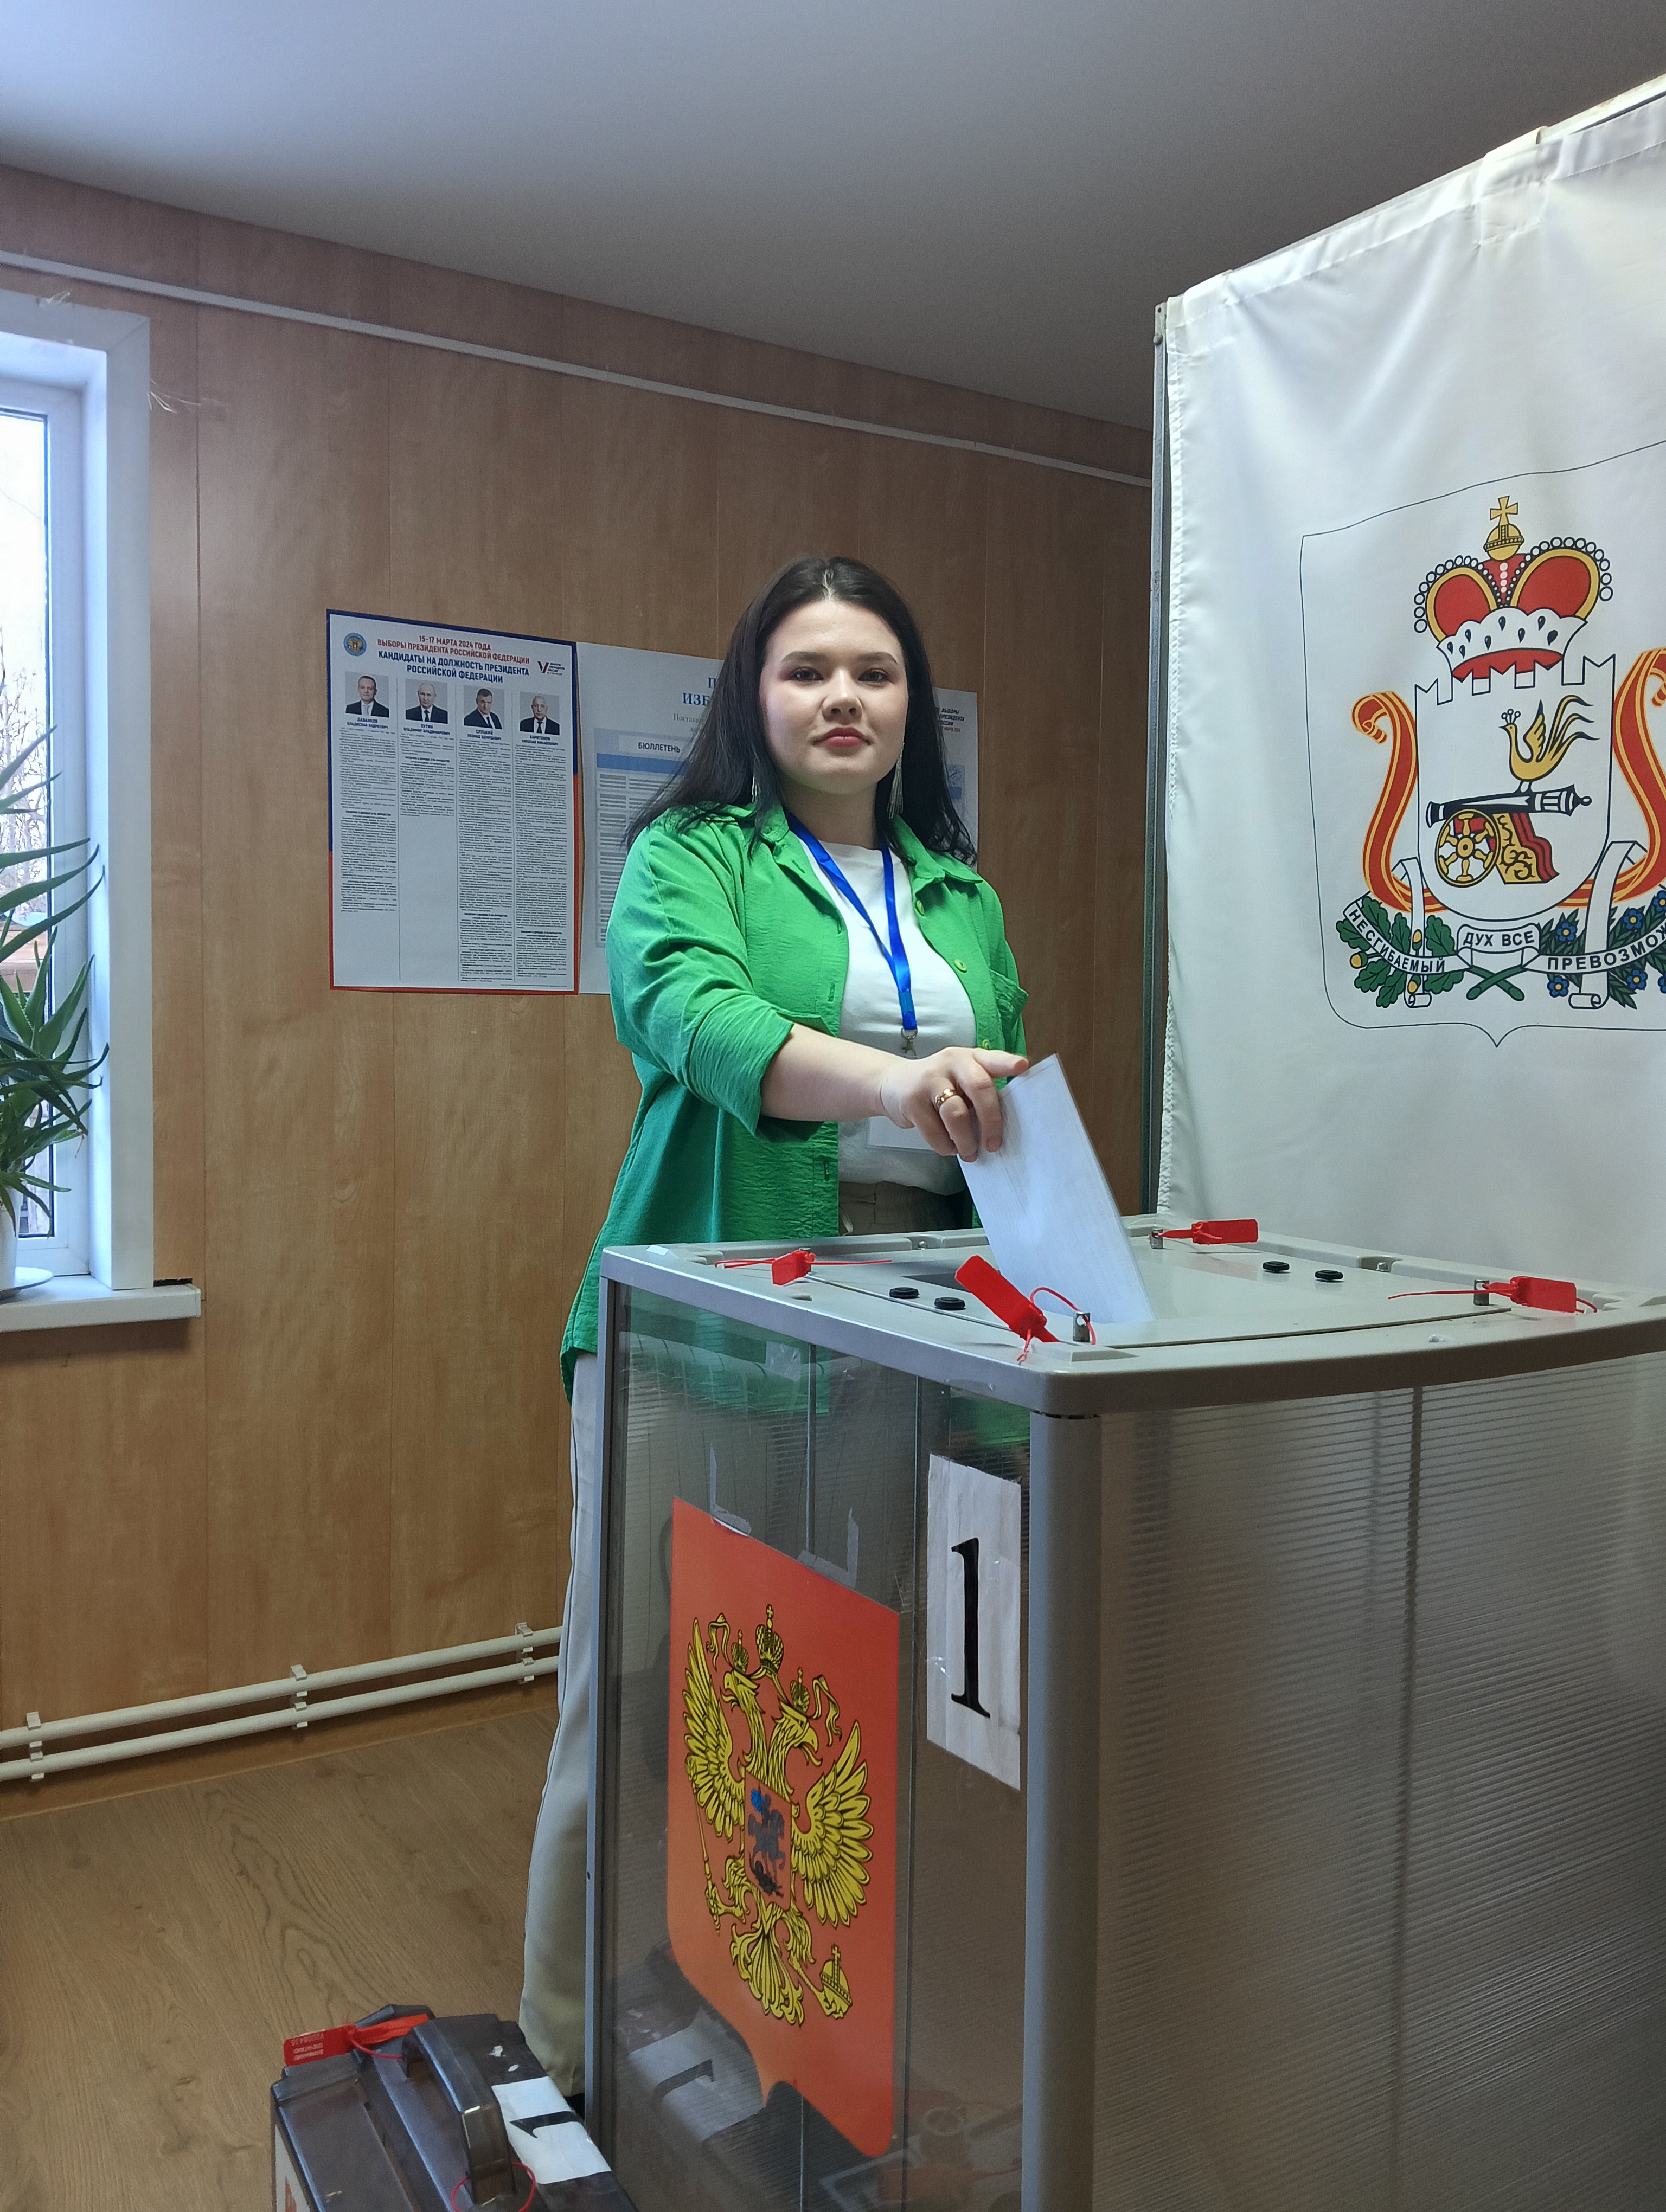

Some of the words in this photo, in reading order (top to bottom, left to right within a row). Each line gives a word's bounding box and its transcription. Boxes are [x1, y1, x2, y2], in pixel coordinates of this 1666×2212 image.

[377, 639, 406, 649] ВЫБОРЫ
[408, 642, 448, 654] ПРЕЗИДЕНТА
[450, 648, 492, 659] РОССИЙСКОЙ
[492, 653, 530, 664] ФЕДЕРАЦИИ
[436, 638, 457, 646] МАРТА
[458, 640, 473, 648] 2024
[475, 642, 491, 651] ГОДА
[378, 650, 425, 664] КАНДИДАТЫ
[426, 656, 437, 666] НА
[438, 657, 483, 671] ДОЛЖНОСТЬ
[484, 663, 529, 677] ПРЕЗИДЕНТА
[407, 664, 457, 678] РОССИЙСКОЙ
[458, 670, 503, 684] ФЕДЕРАЦИИ
[638, 742, 681, 754] БЮЛЛЕТЕНЬ
[1349, 908, 1446, 973] НЕСГИБАЕМЫЙ
[1463, 931, 1494, 947] ДУХ
[1502, 930, 1535, 947] ВСЕ
